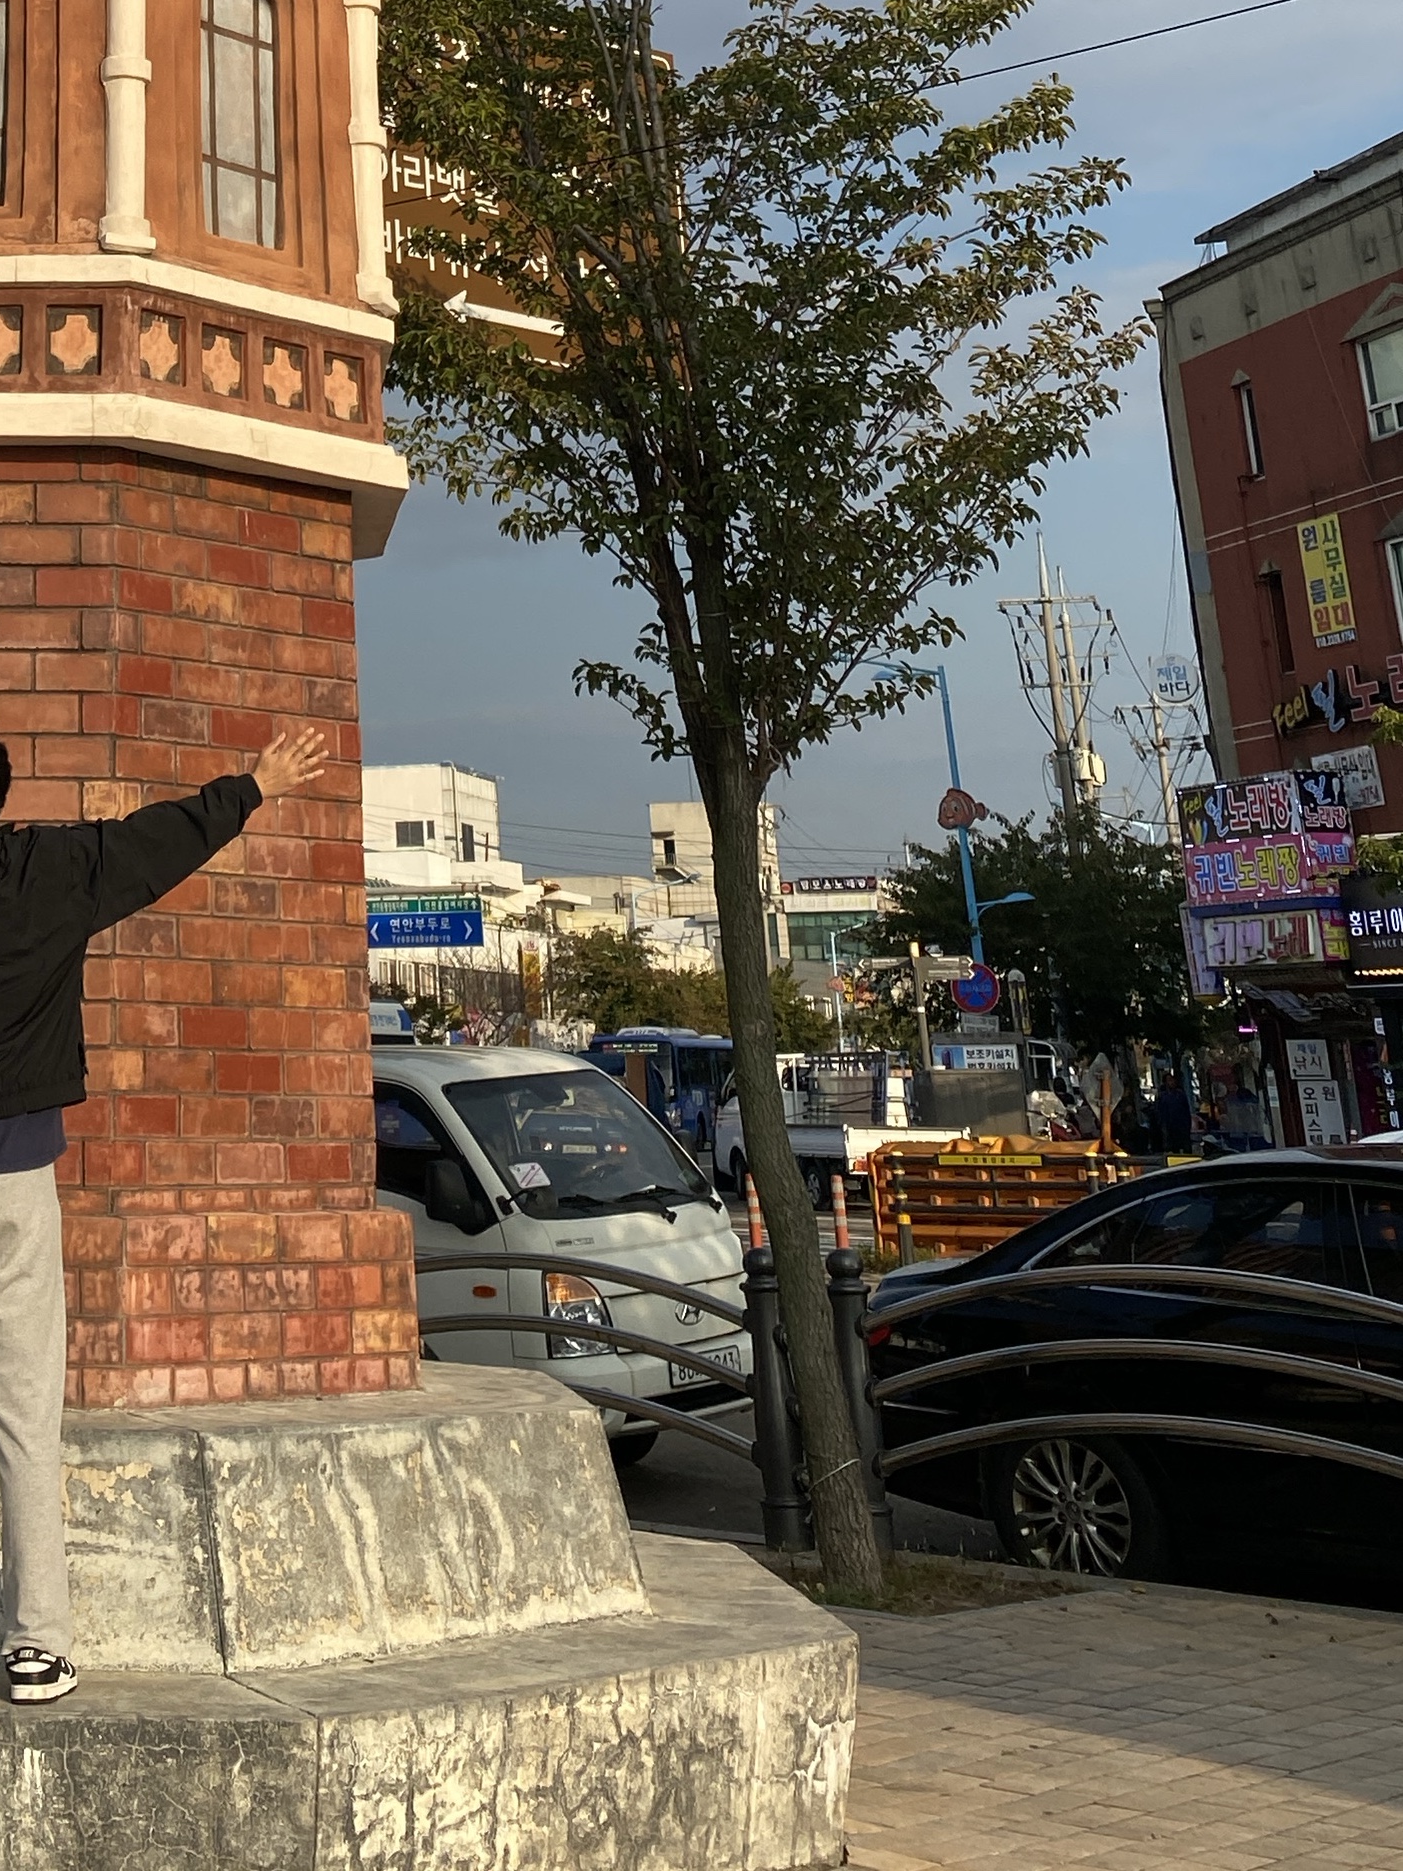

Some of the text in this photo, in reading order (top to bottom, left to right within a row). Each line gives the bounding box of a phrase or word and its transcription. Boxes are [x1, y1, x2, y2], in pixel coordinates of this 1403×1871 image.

[1322, 519, 1347, 600] 사무실
[1313, 601, 1352, 633] 임대
[1157, 665, 1188, 682] 제일
[1158, 680, 1191, 698] 바다
[1226, 780, 1291, 830] 노래방
[1304, 805, 1347, 829] 노래방
[389, 917, 452, 933] 연안부두로
[391, 934, 452, 944] Yeonanbudu-ro
[966, 1048, 1015, 1060] 보조키설치
[1294, 1055, 1323, 1071] 낚시
